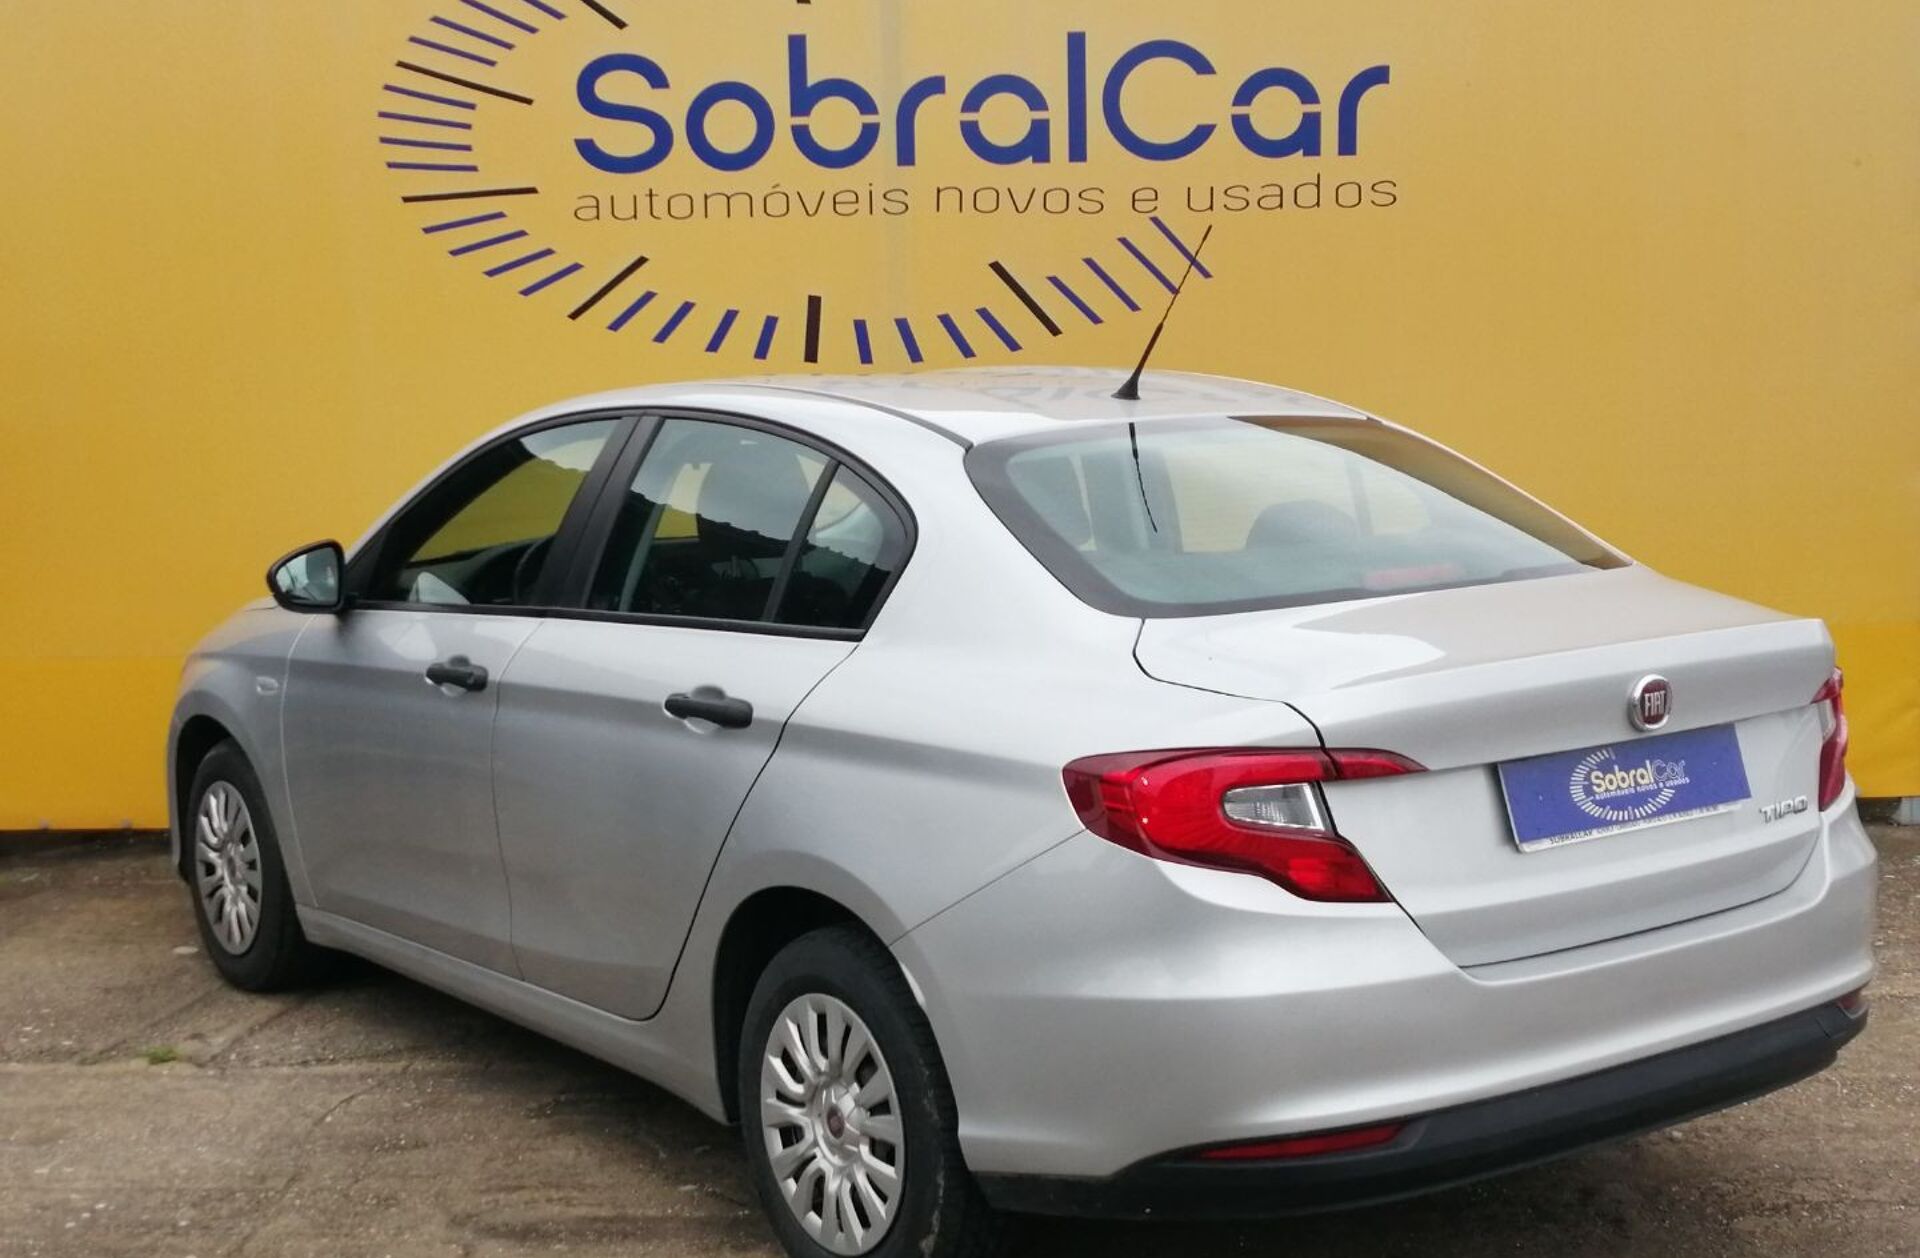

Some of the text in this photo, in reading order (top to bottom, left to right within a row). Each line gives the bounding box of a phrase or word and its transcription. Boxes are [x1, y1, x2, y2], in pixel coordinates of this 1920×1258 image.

[573, 30, 1391, 174] SobralCar
[574, 172, 1398, 222] automóveis novos e usados
[1644, 690, 1665, 717] FIAT
[1590, 759, 1686, 793] SobralCar
[1759, 795, 1808, 824] TIPO
